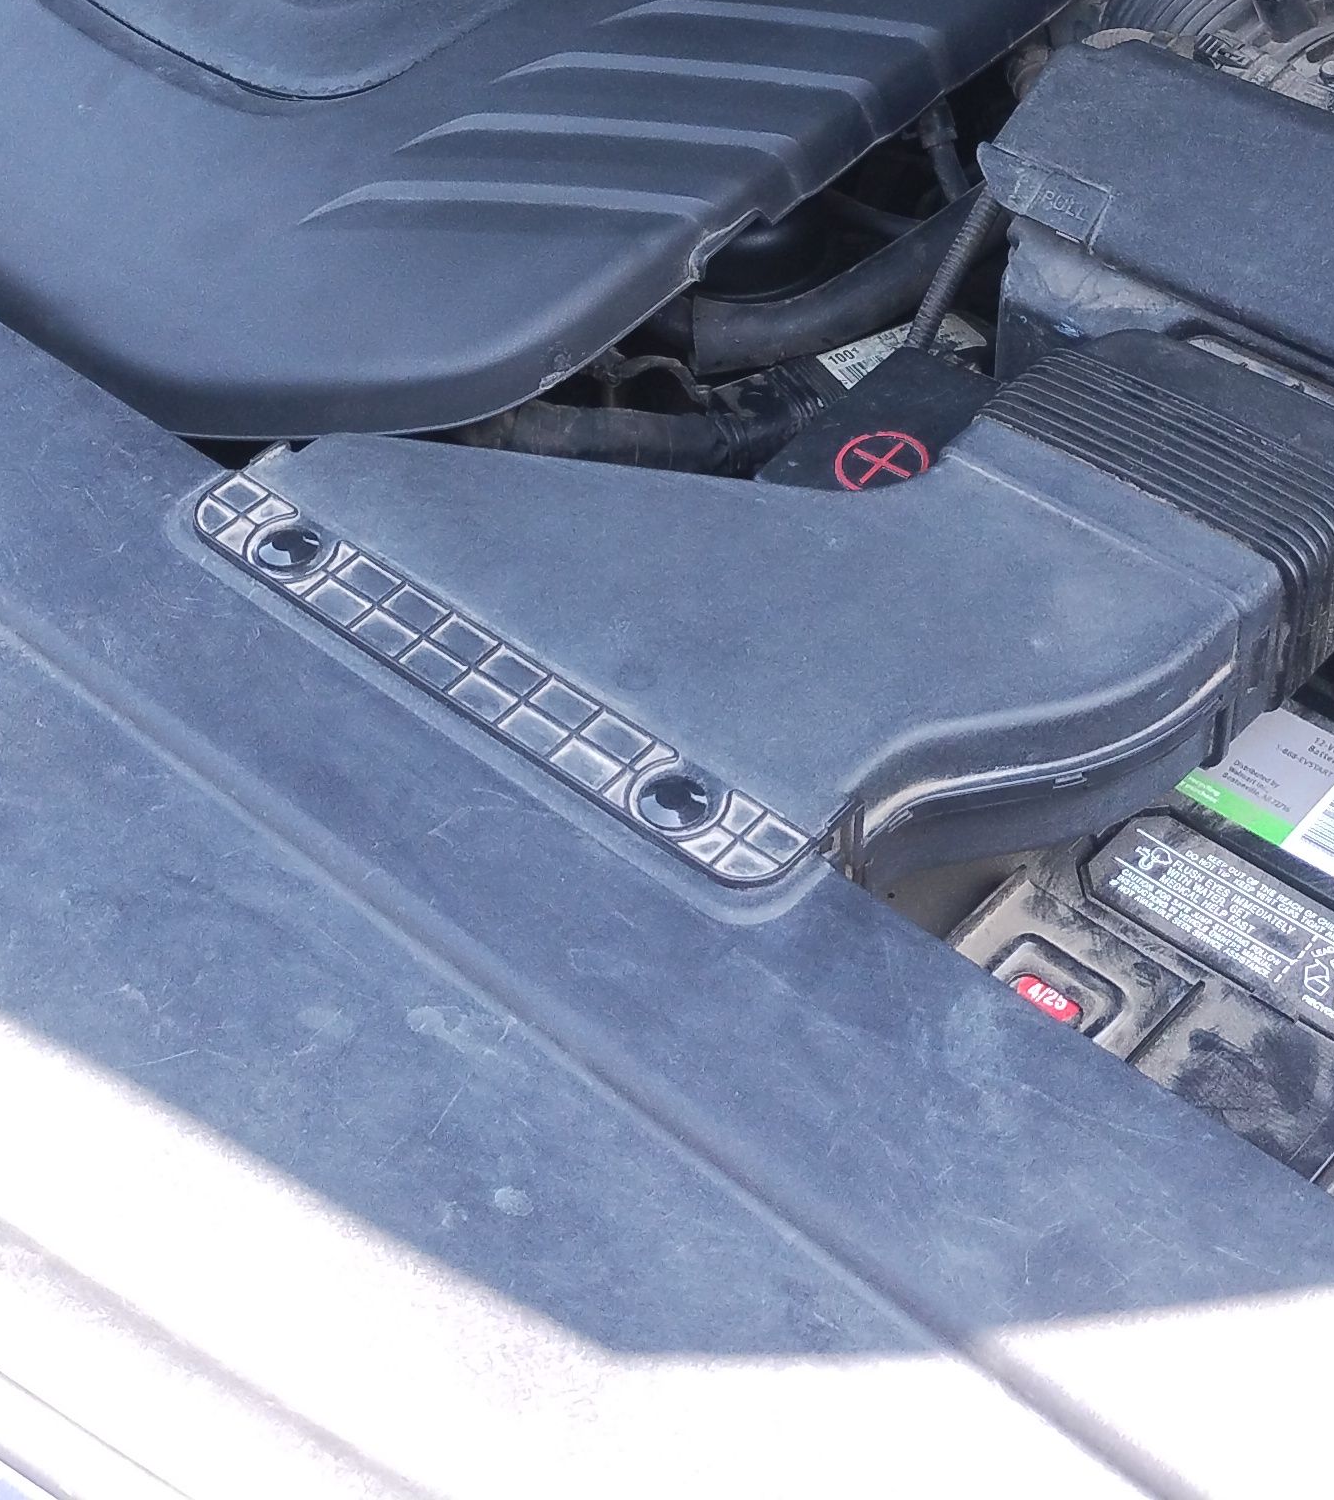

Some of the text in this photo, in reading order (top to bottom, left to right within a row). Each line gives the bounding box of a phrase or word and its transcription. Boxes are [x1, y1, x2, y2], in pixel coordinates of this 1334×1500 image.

[1042, 189, 1086, 221] PULL
[1116, 874, 1168, 908] INSTRUCTIONS
[1178, 910, 1209, 932] VEHICLE
[1117, 884, 1135, 897] NOT
[1133, 895, 1173, 920] AVAILABLE
[1171, 917, 1192, 932] SEEK
[1191, 929, 1223, 950] SERVICE
[1158, 874, 1255, 934] MEDICAL HELP FAST
[1166, 866, 1192, 886] WITH
[1229, 904, 1251, 919] GET
[1172, 859, 1296, 935] FLUSH EYES IMMEDIATELY
[1184, 850, 1198, 860] DO
[1198, 857, 1216, 870] NOT
[1232, 878, 1255, 892] KEEP
[1255, 890, 1277, 905] VENT
[1277, 903, 1300, 919] CAPS
[1300, 915, 1325, 932] TIGHT
[1206, 854, 1228, 867] KEEP
[1227, 866, 1246, 879] OUT
[1259, 883, 1277, 897] THE
[1275, 893, 1304, 913] REACH
[1303, 909, 1318, 918] OF
[1154, 889, 1171, 901] FOR
[1170, 898, 1192, 913] SAFE
[1190, 911, 1212, 924] JUMP
[1211, 923, 1250, 947] STARTING
[1248, 944, 1281, 965] FOLLOW
